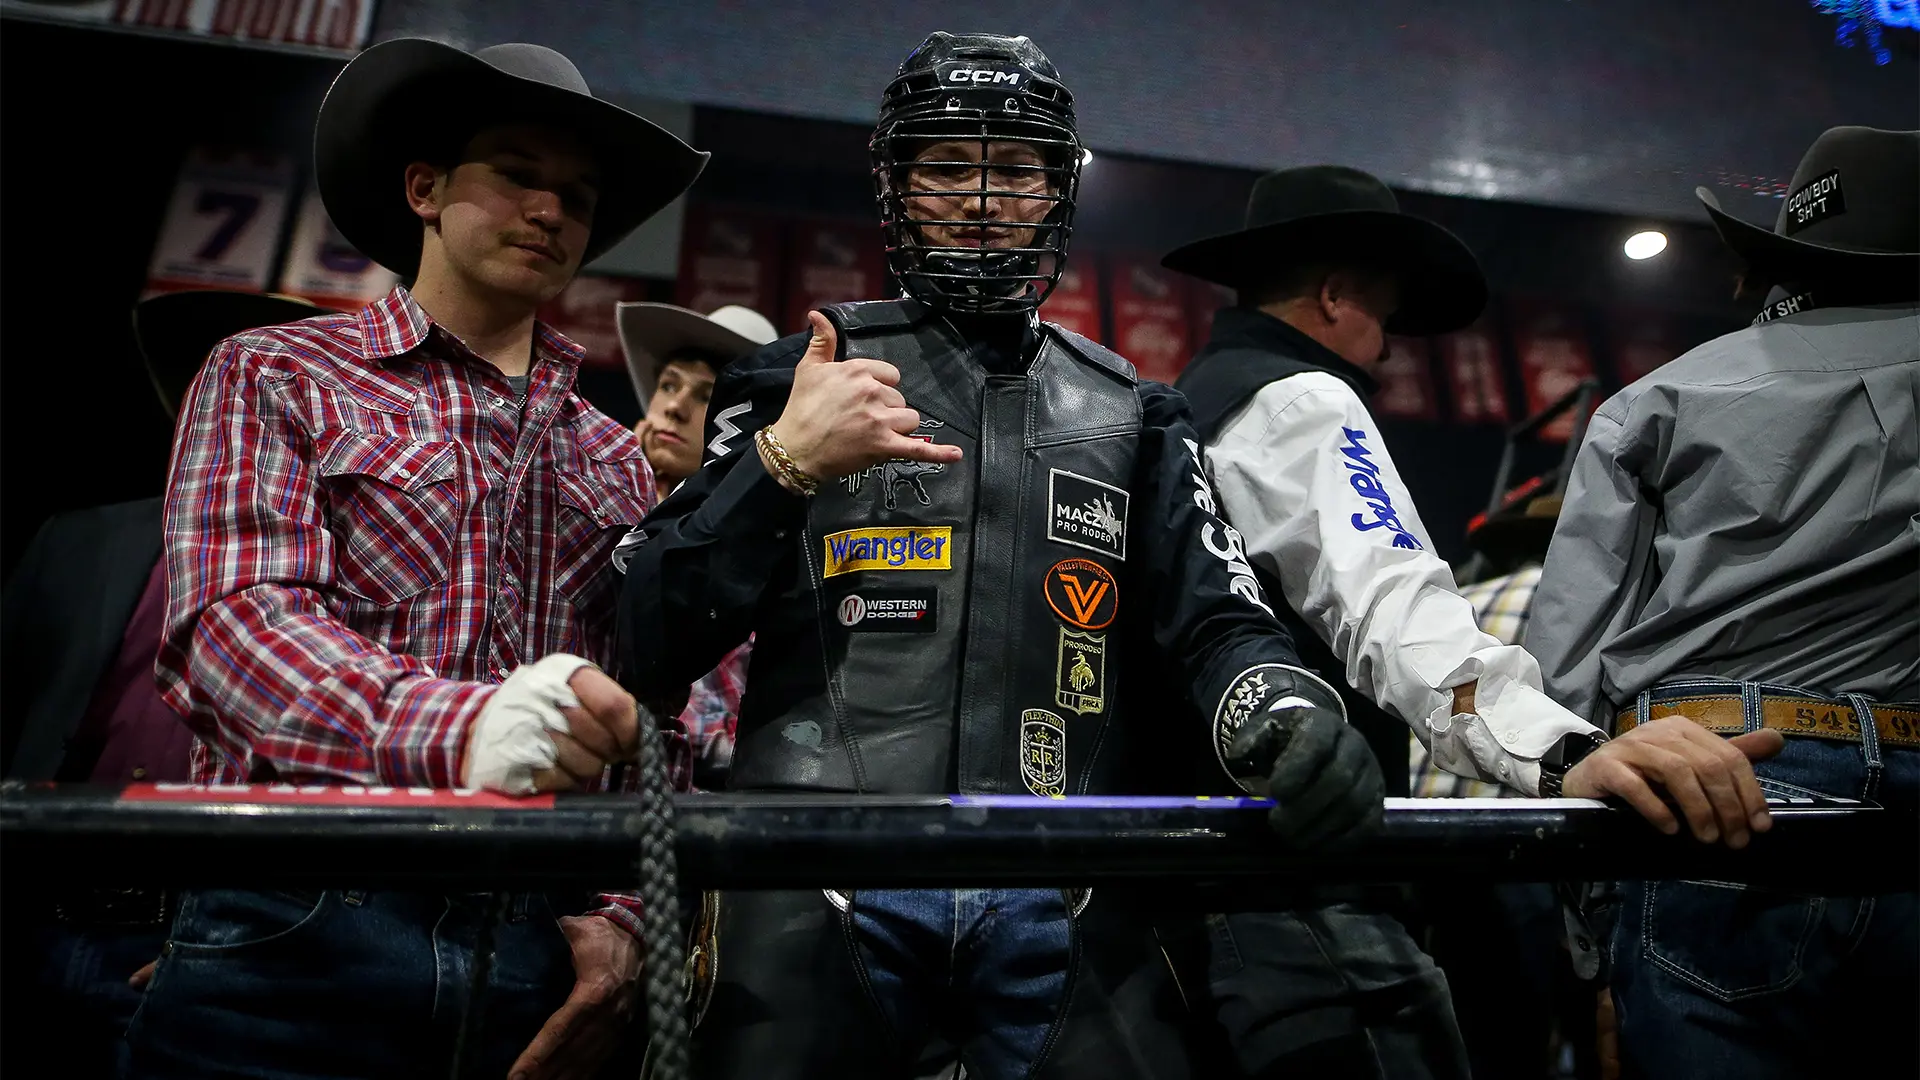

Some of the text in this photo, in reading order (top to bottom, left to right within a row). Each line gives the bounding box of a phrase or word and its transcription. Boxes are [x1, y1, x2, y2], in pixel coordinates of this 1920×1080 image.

[949, 70, 1020, 85] CCM
[1788, 173, 1839, 214] COWBOY
[198, 191, 258, 260] 7
[1056, 520, 1112, 543] PRO RODEO
[829, 530, 947, 566] Wrangler
[866, 599, 927, 611] WESTERN
[866, 611, 918, 619] DODGE
[1064, 639, 1102, 654] PRORODEO
[1031, 782, 1060, 795] PRO
